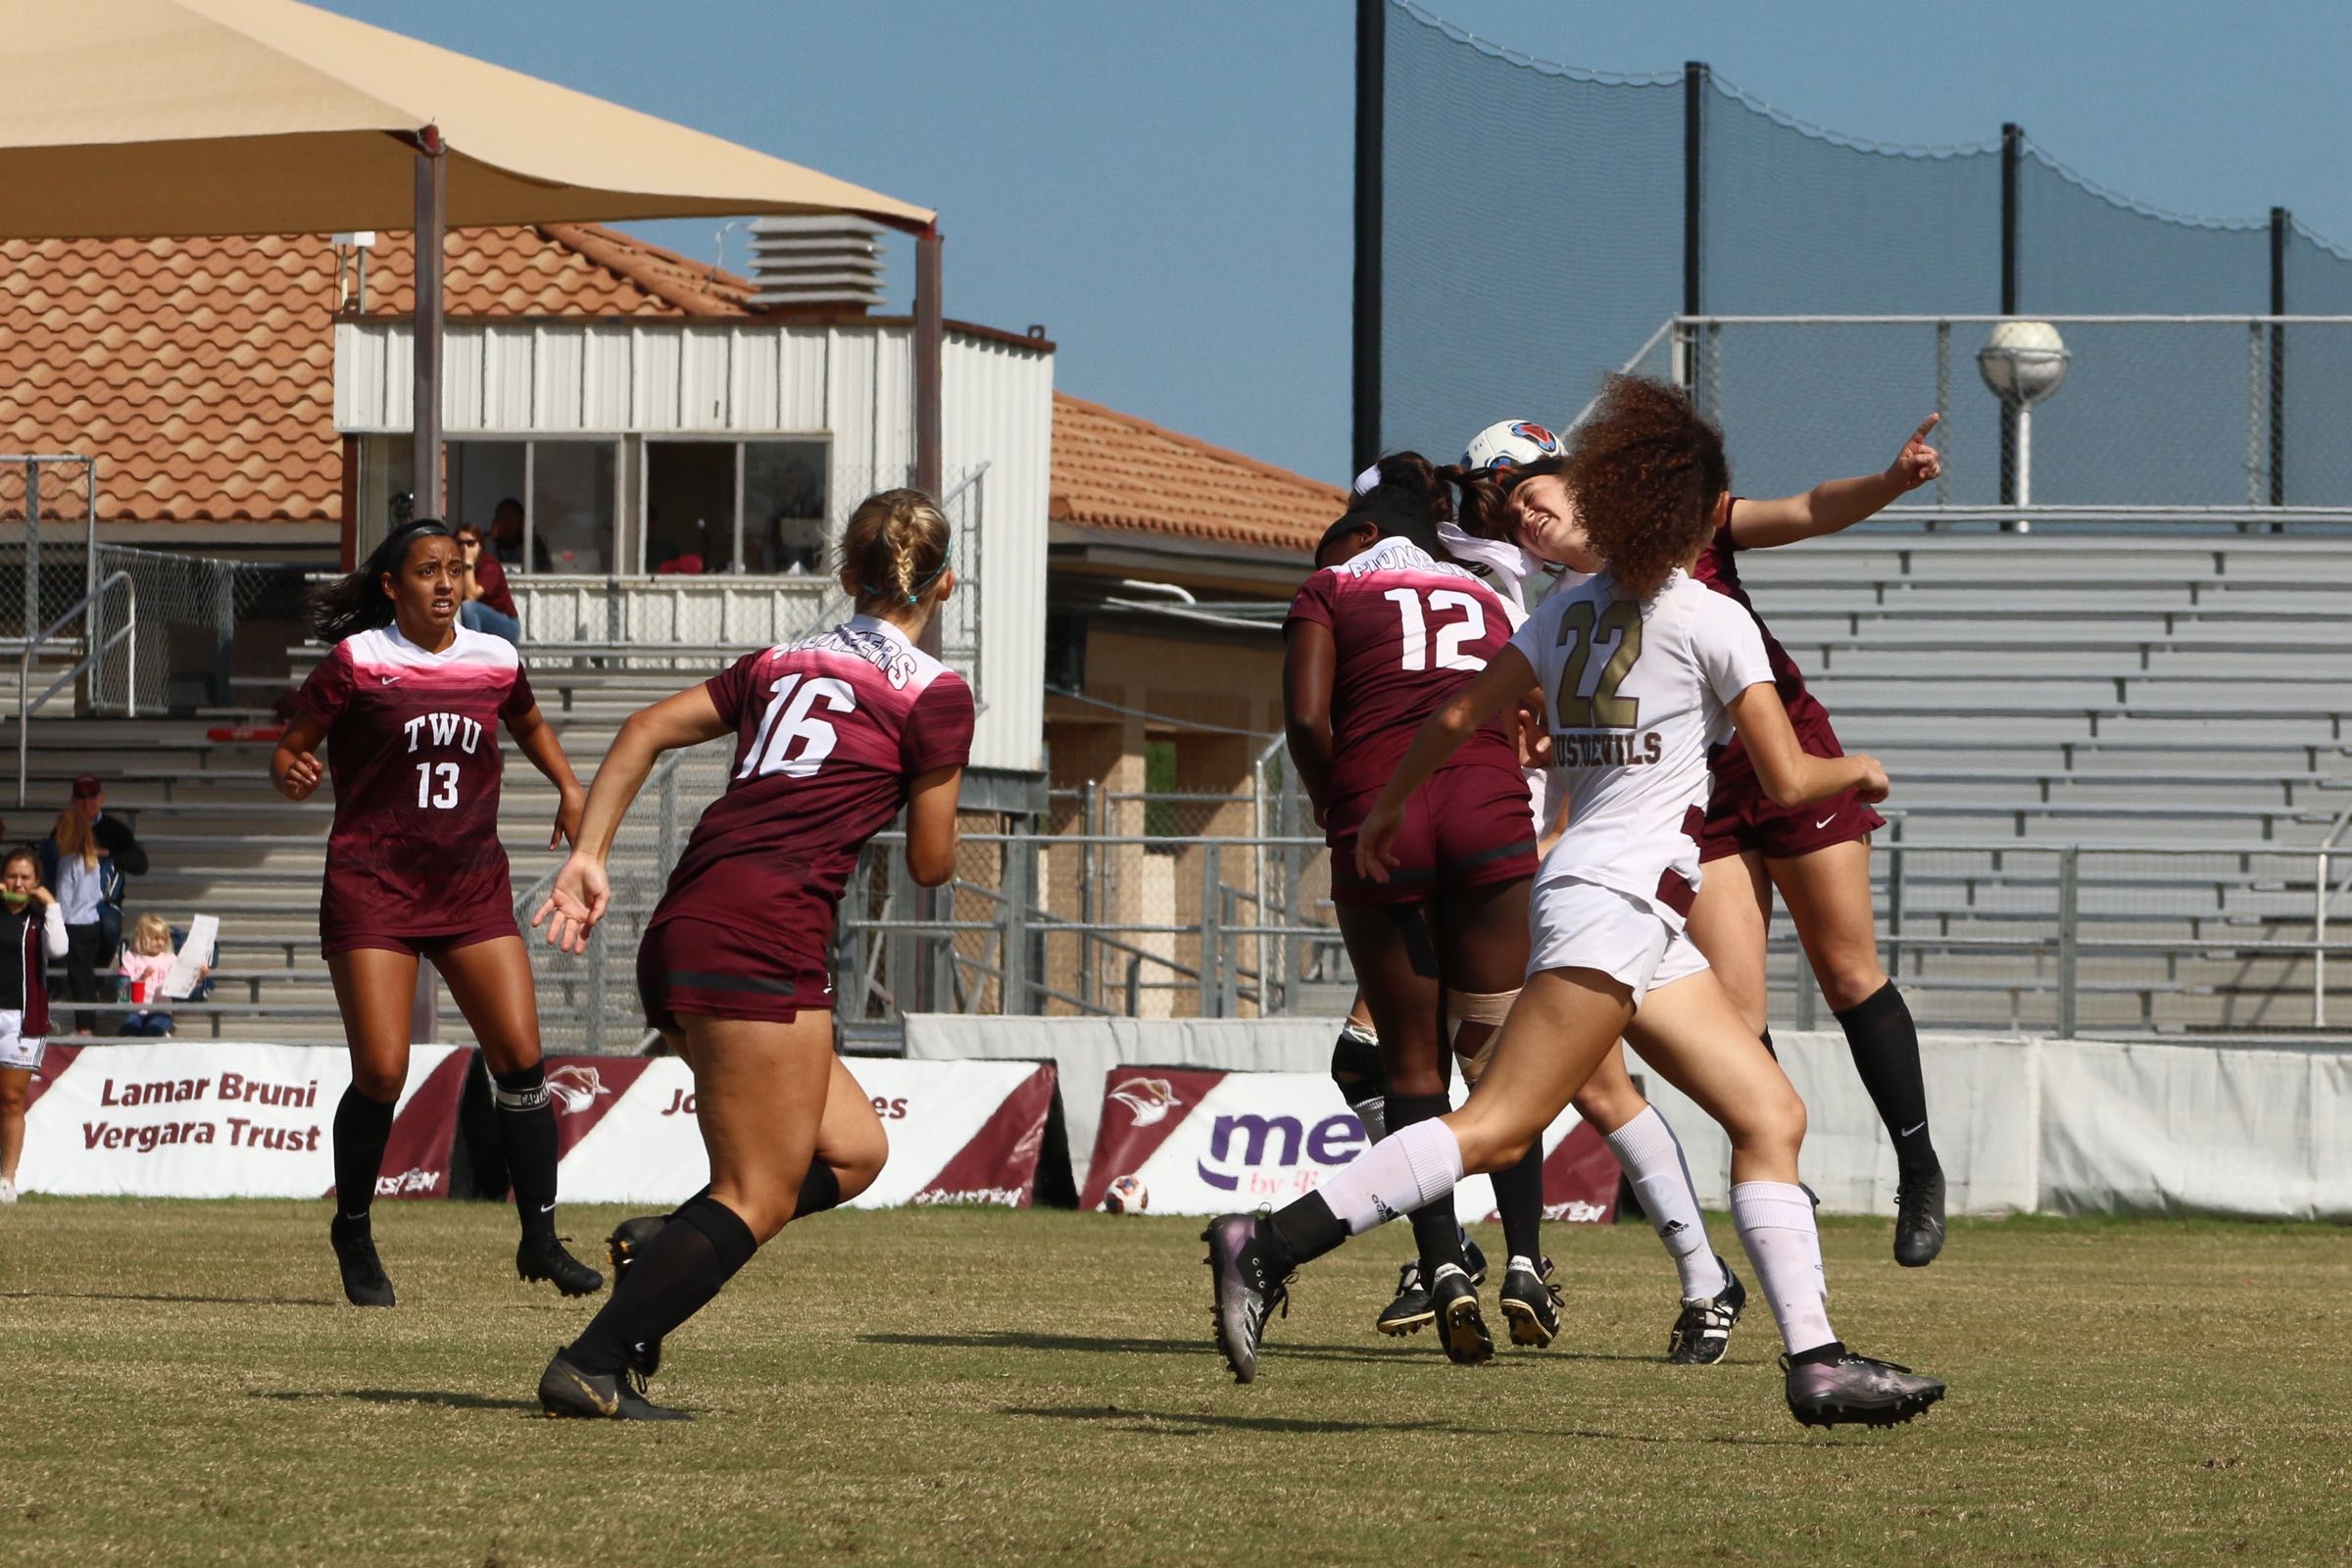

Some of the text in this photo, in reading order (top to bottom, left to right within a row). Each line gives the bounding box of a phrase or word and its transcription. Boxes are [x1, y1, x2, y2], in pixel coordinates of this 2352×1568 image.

[1384, 588, 1489, 672] 12
[1555, 599, 1644, 729] 22
[404, 712, 483, 755] TWU
[735, 672, 858, 779] 16
[416, 761, 461, 809] 13
[101, 1071, 318, 1108] Lamar Bruni
[82, 1116, 321, 1153] Vergara Trust
[1250, 1171, 1284, 1198] by
